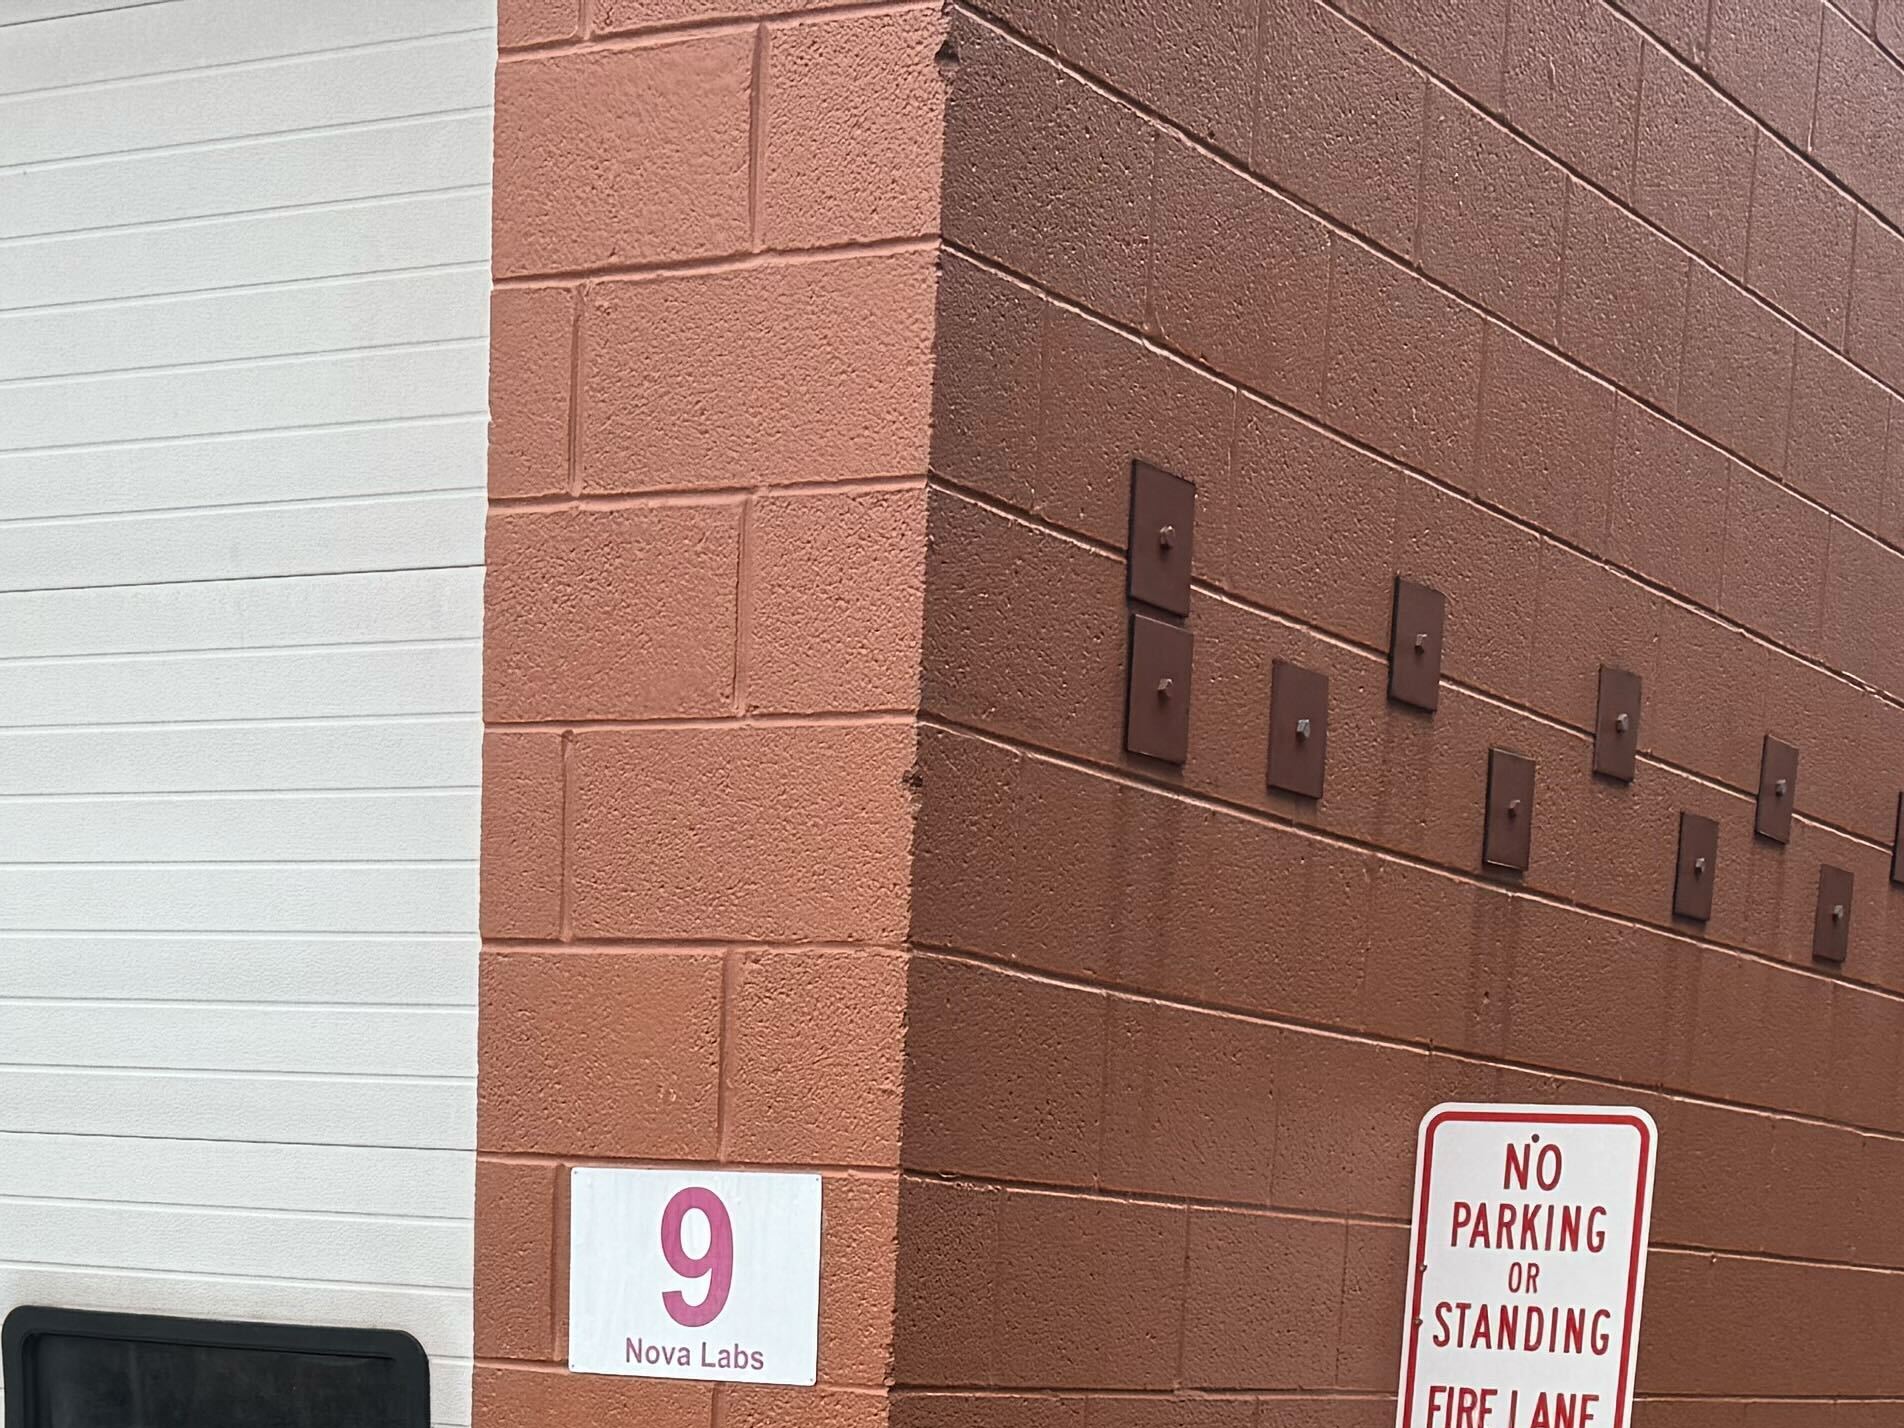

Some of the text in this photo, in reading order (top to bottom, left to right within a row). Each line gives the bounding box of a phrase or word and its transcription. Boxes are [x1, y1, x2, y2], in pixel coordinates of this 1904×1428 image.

[1503, 1143, 1563, 1192] NO
[1450, 1201, 1608, 1254] PARKING
[660, 1186, 734, 1328] 9
[1508, 1261, 1540, 1294] OR
[625, 1336, 765, 1371] Nova Labs
[1432, 1301, 1612, 1357] STANDING
